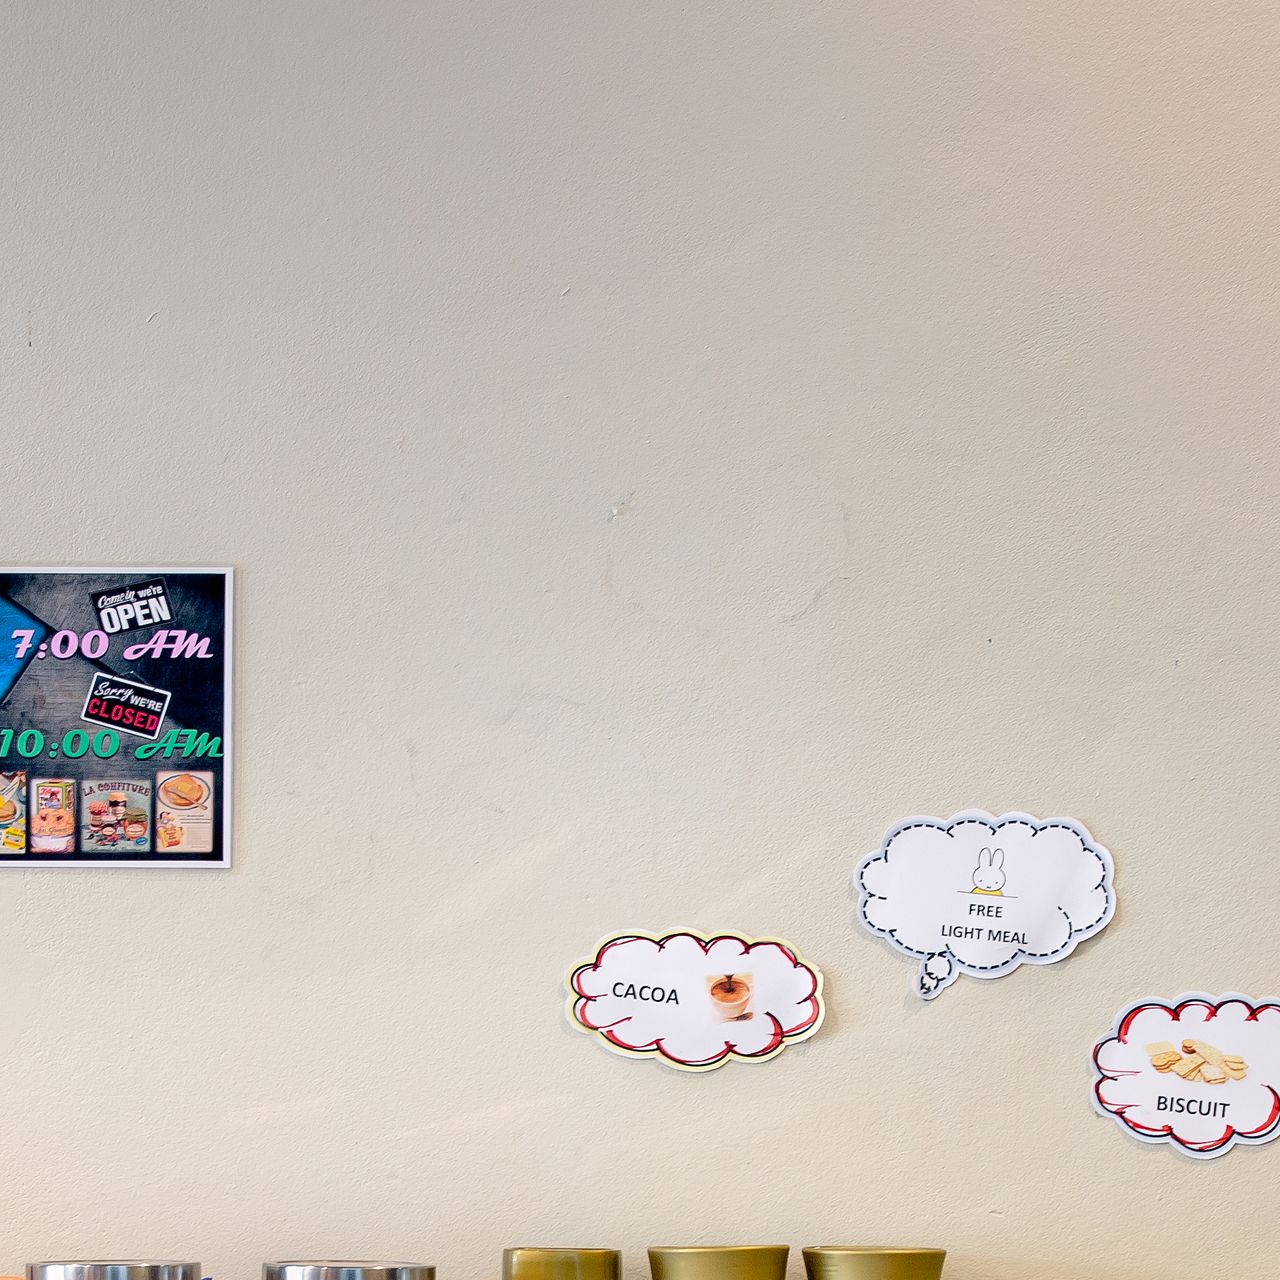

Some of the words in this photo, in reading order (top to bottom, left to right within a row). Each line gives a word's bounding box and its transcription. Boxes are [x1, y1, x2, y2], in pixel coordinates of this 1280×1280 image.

[136, 584, 163, 598] we're
[99, 595, 172, 634] OPEN
[11, 629, 109, 660] 7:00
[123, 629, 214, 661] AM
[93, 681, 134, 702] Sorry
[130, 694, 163, 712] WE'RE
[87, 698, 159, 732] CLOSED
[134, 728, 224, 760] AM
[83, 786, 96, 797] LA
[968, 903, 1004, 918] FREE
[941, 924, 983, 941] LIGHT
[987, 929, 1029, 945] MEAL
[612, 982, 680, 1005] CACOA
[1156, 1095, 1231, 1118] BISCUIT
